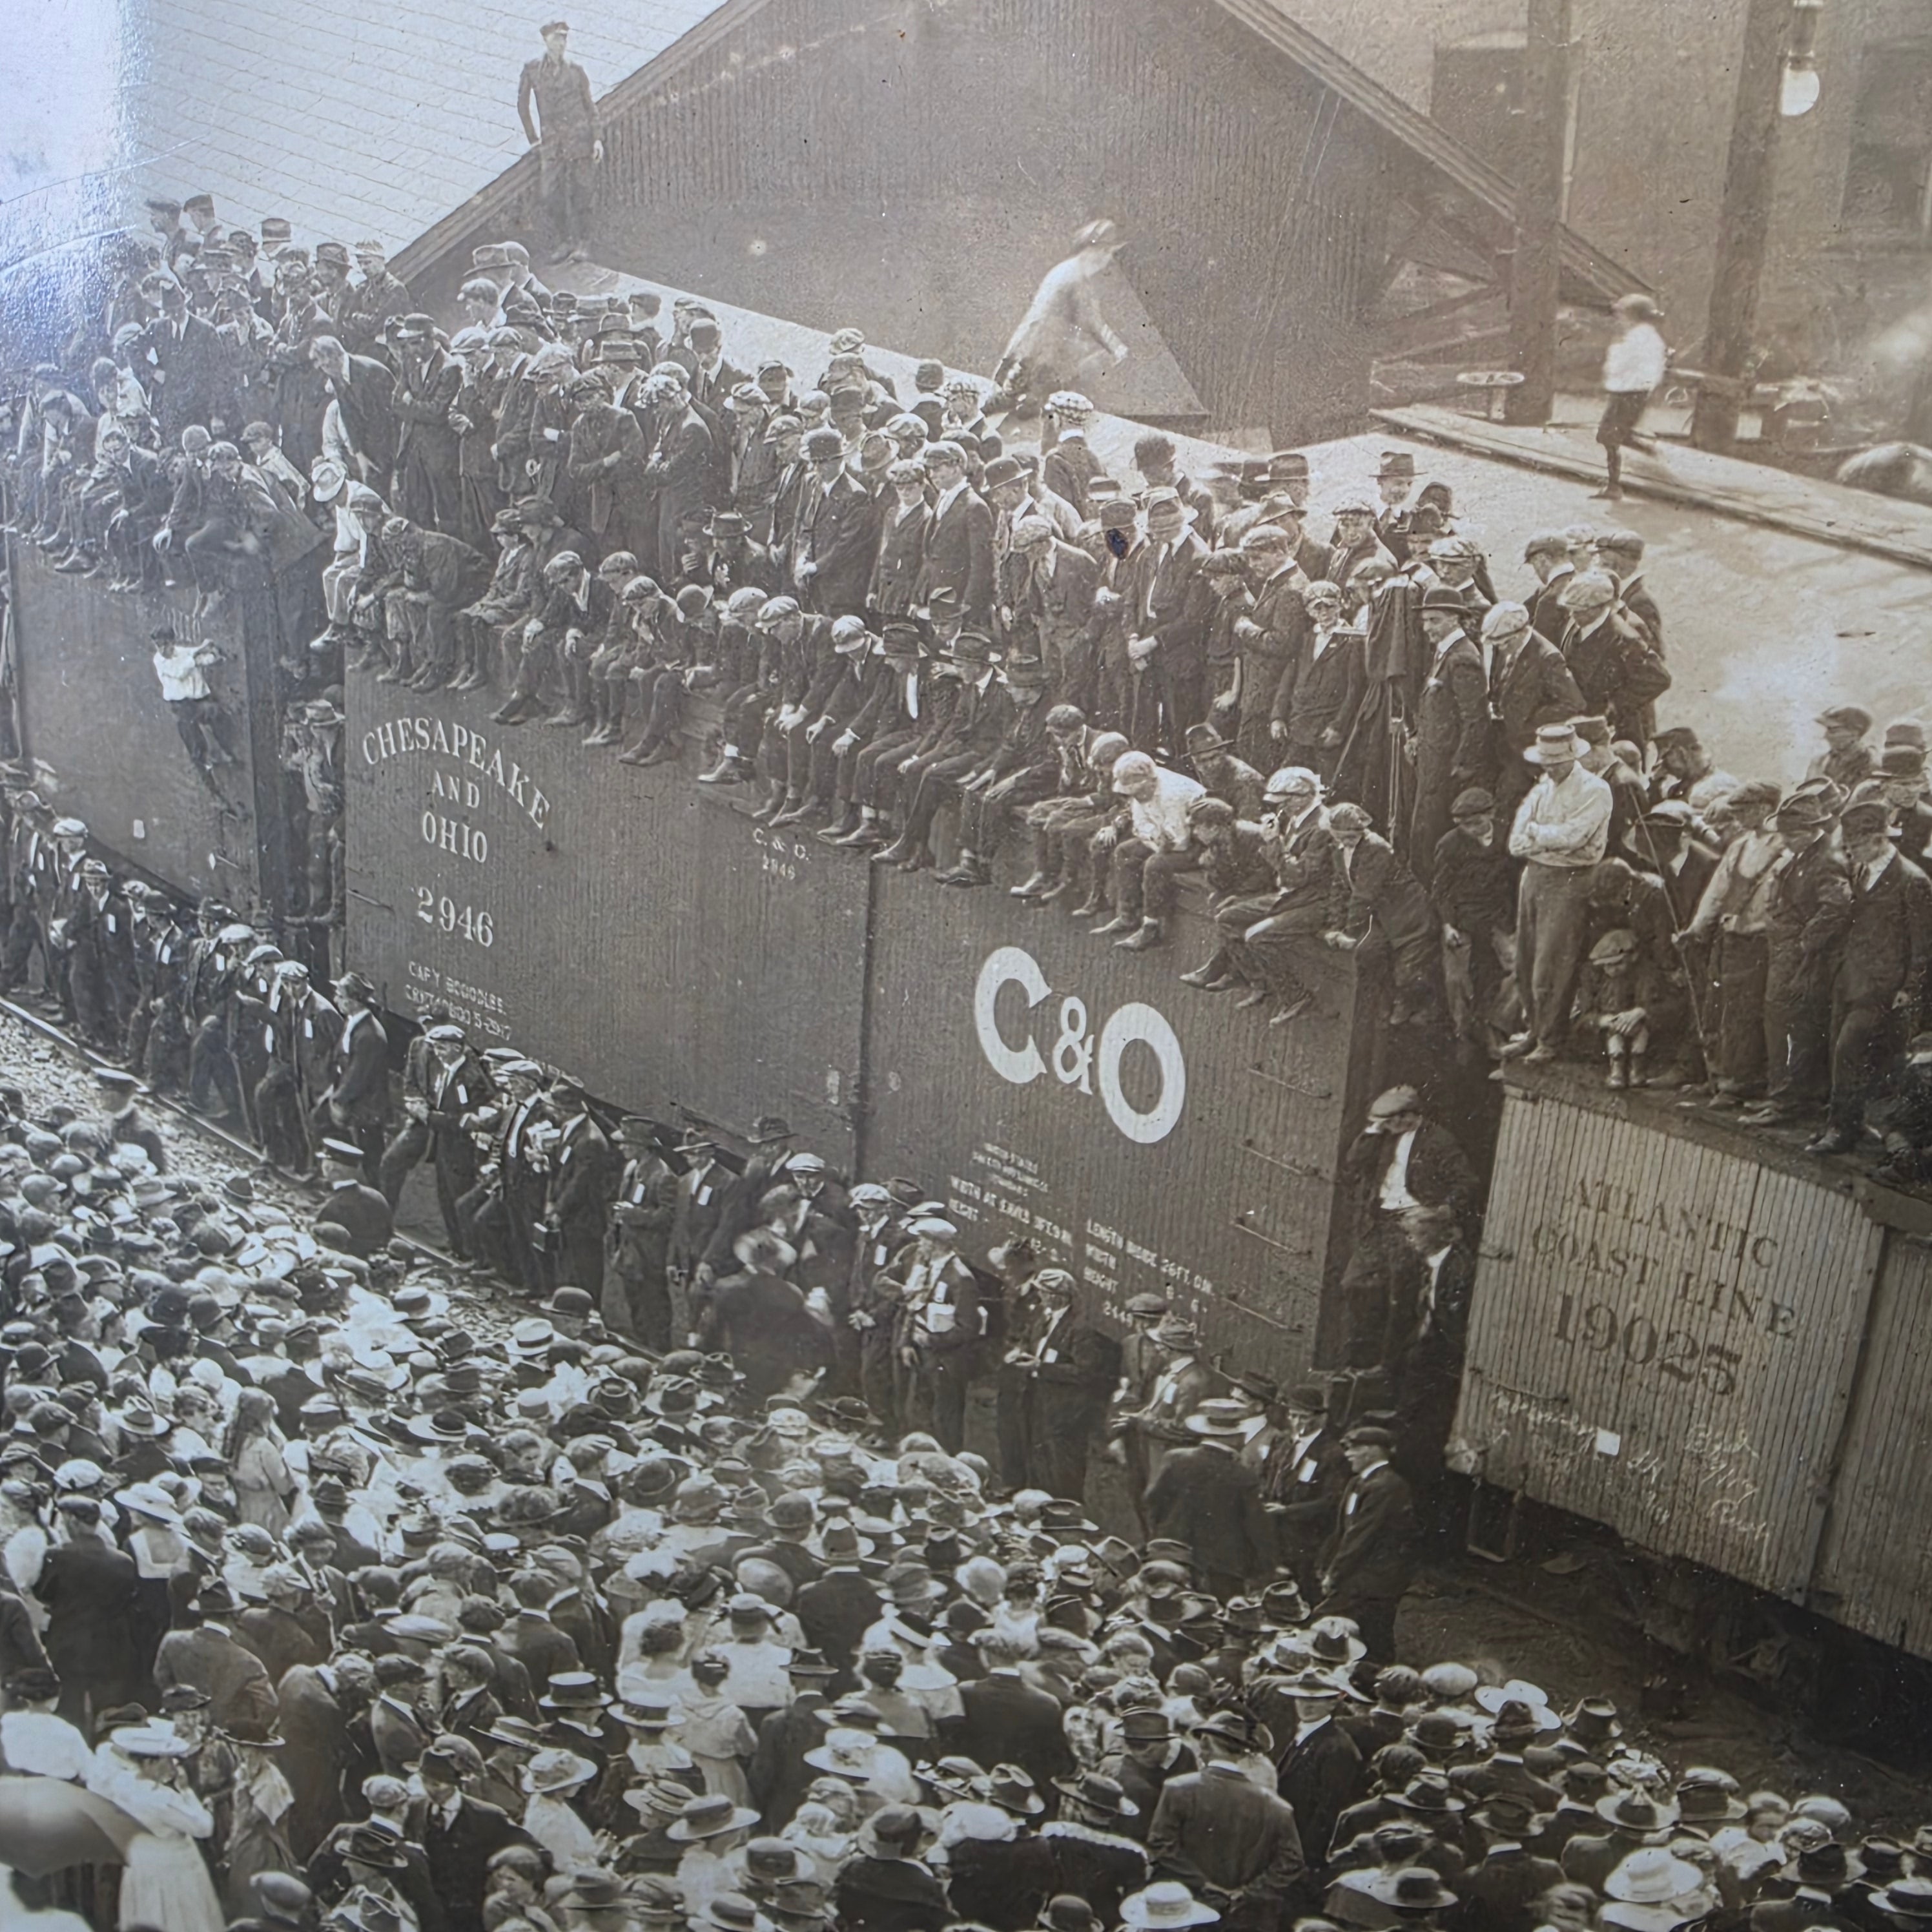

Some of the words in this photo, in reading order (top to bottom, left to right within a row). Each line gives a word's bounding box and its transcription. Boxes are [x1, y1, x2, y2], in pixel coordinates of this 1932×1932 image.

[363, 717, 550, 830] CHESAPEAKE
[431, 769, 480, 808] AND
[422, 811, 488, 863] OHIO
[418, 887, 493, 947] 2946
[974, 946, 1186, 1144] C&O
[1569, 1178, 1778, 1268] ATLANTIC
[1532, 1224, 1660, 1285] COAST
[1679, 1271, 1796, 1339] LINE
